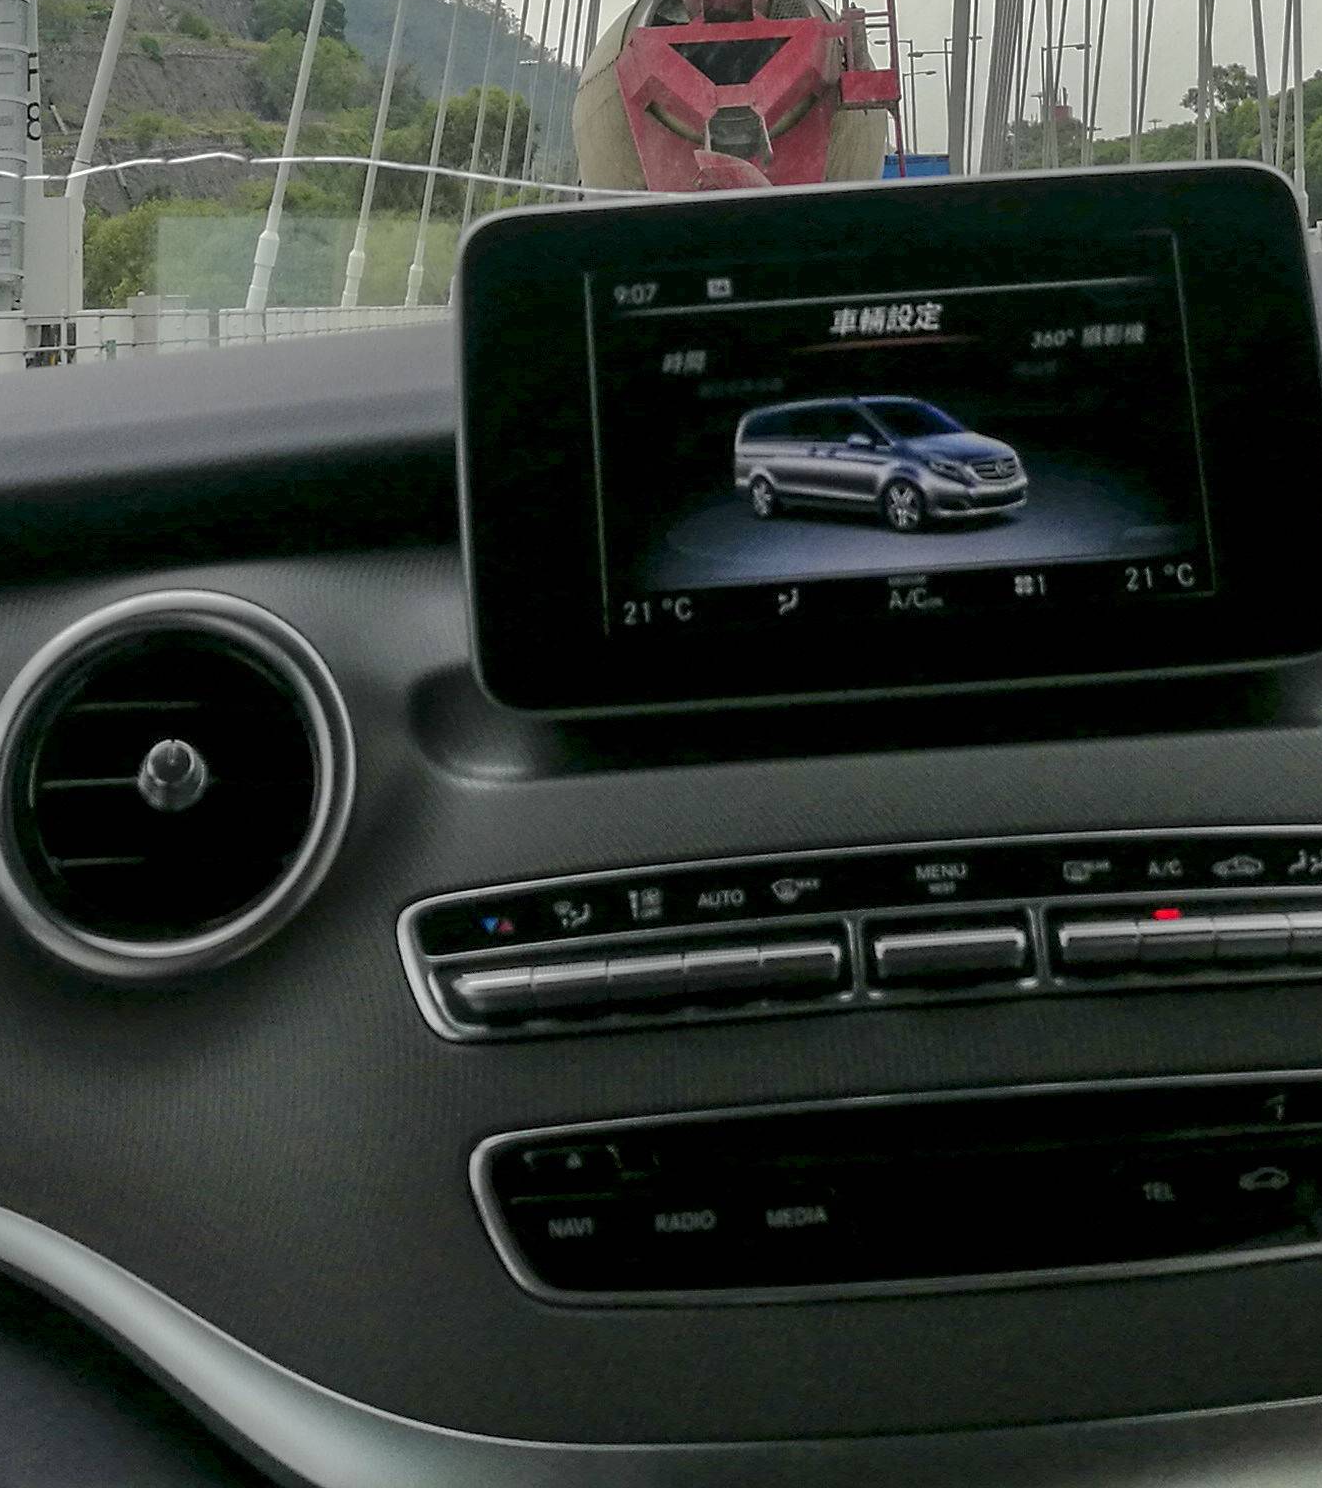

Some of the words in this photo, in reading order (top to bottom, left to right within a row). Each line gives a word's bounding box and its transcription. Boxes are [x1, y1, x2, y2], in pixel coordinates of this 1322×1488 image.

[613, 283, 660, 304] 9:07
[1126, 566, 1154, 592] 21
[623, 599, 652, 625] 21
[915, 863, 968, 880] MENU
[697, 889, 746, 907] AUTO
[548, 1216, 595, 1239] NAVI
[654, 1209, 717, 1232] RADIO
[765, 1205, 828, 1228] MEDIA
